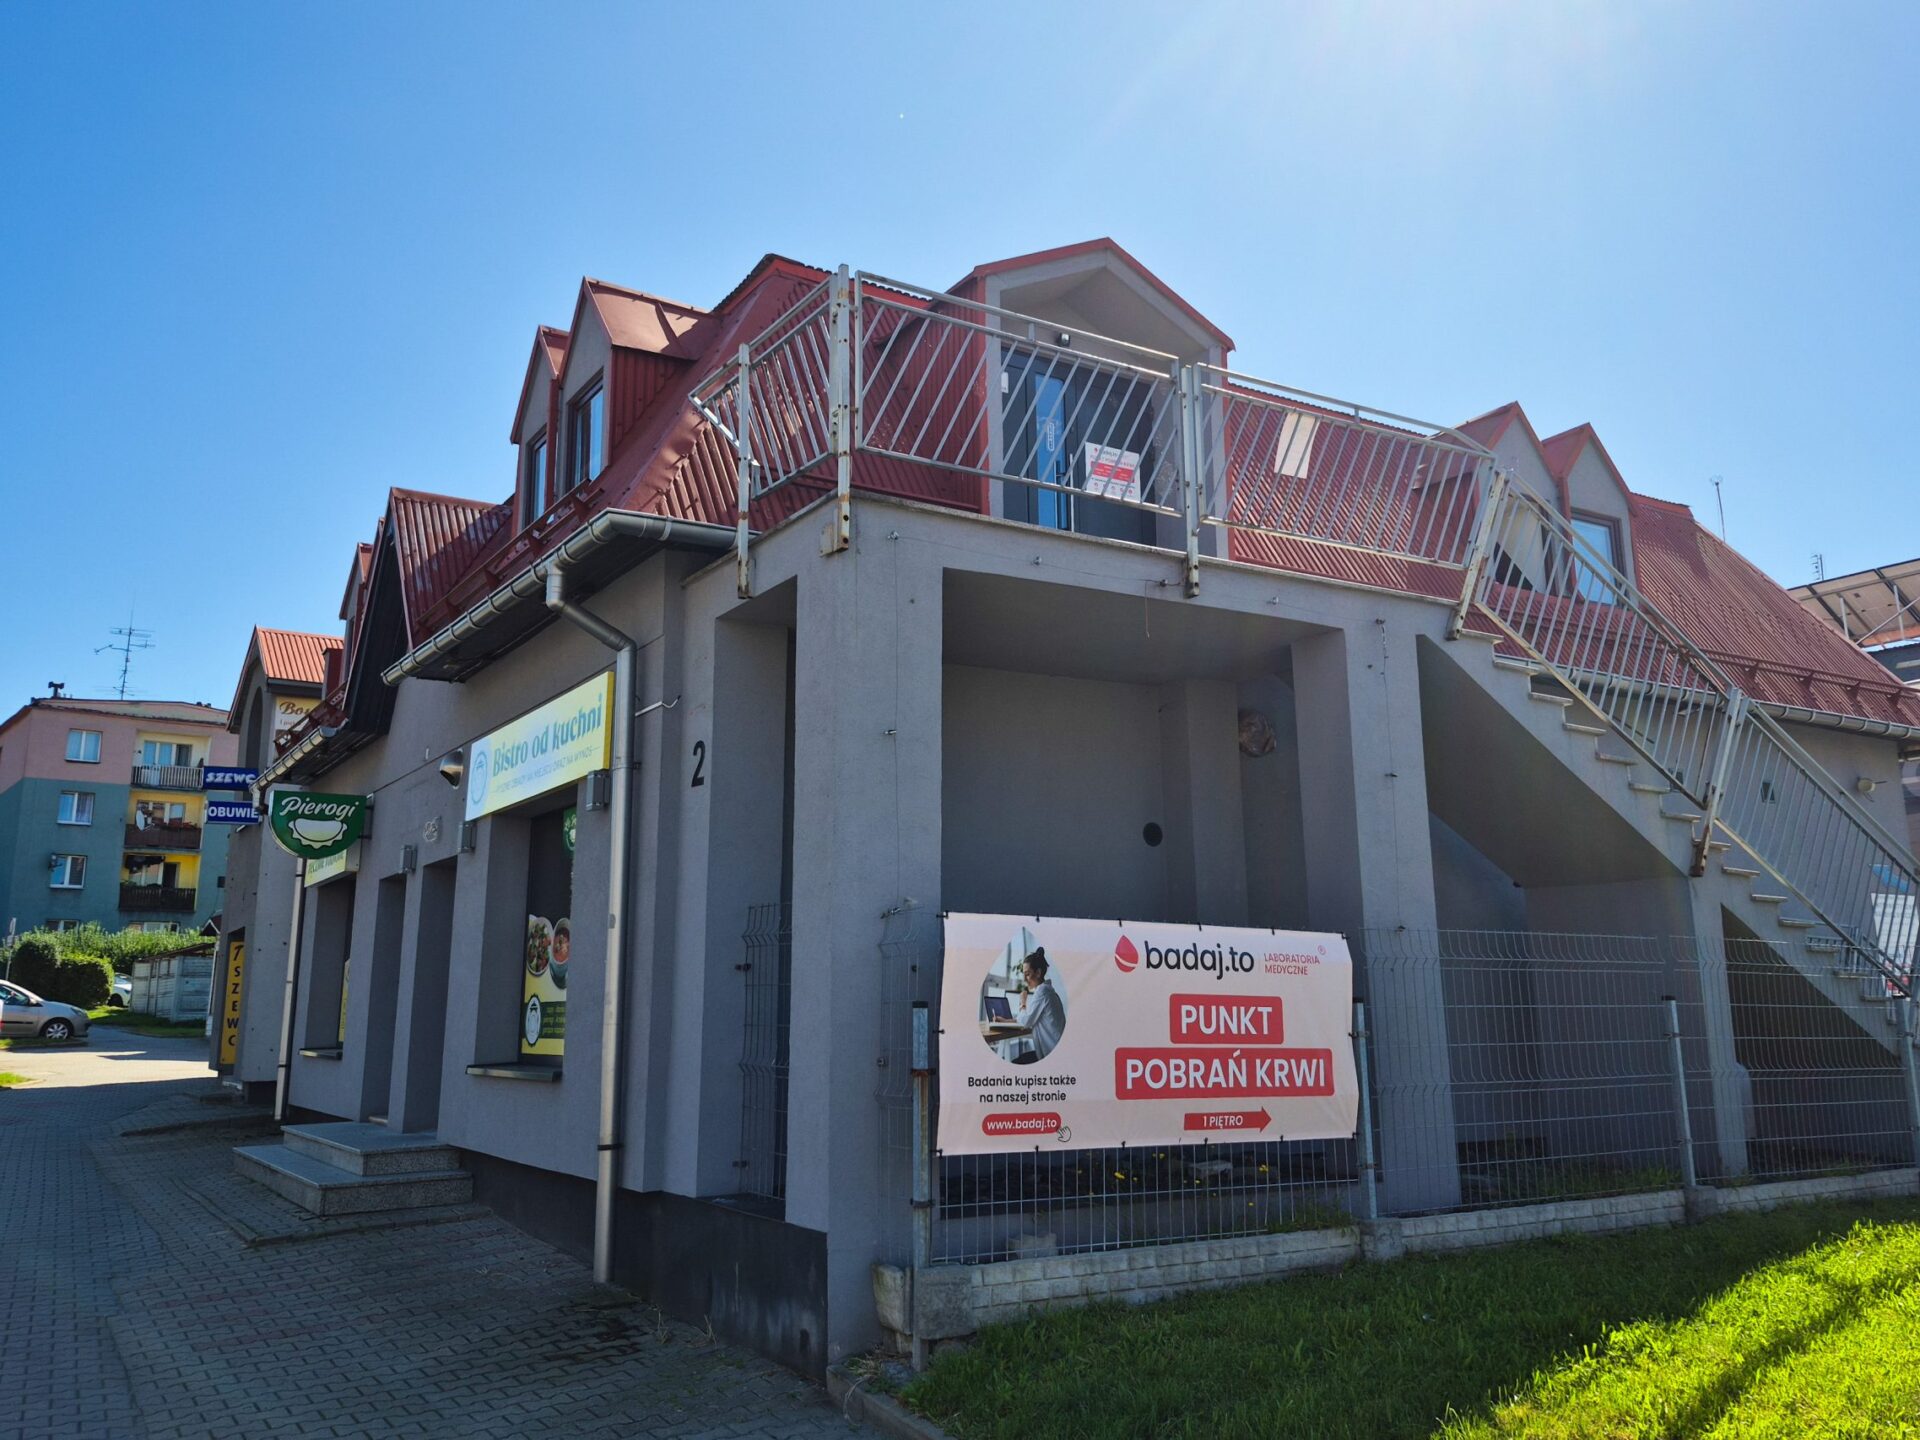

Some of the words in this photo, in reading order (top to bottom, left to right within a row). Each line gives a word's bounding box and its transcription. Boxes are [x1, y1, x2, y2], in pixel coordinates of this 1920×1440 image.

[493, 741, 529, 777] Bistro
[532, 725, 550, 758] od
[552, 692, 603, 751] kuchni
[691, 740, 706, 787] 2
[205, 772, 256, 784] SZEWC
[208, 806, 259, 819] OBUWIE
[279, 796, 360, 821] Pierogi
[1144, 940, 1255, 980] badaj.to
[1263, 952, 1321, 965] LABORATORIA
[1264, 963, 1309, 976] MEDYCZNE
[1181, 1004, 1273, 1035] PUNKT
[1126, 1049, 1247, 1089] POBRAŃ
[1255, 1058, 1325, 1088] KRWI
[968, 1076, 1013, 1087] Badania
[1014, 1075, 1047, 1089] kupisz
[1049, 1074, 1077, 1086] także
[979, 1094, 993, 1103] na
[996, 1091, 1029, 1105] naszej
[1031, 1090, 1067, 1102] stronie
[987, 1118, 1058, 1132] www.badaj.to
[1203, 1115, 1208, 1127] 1
[1209, 1115, 1244, 1130] PIĘTRO
